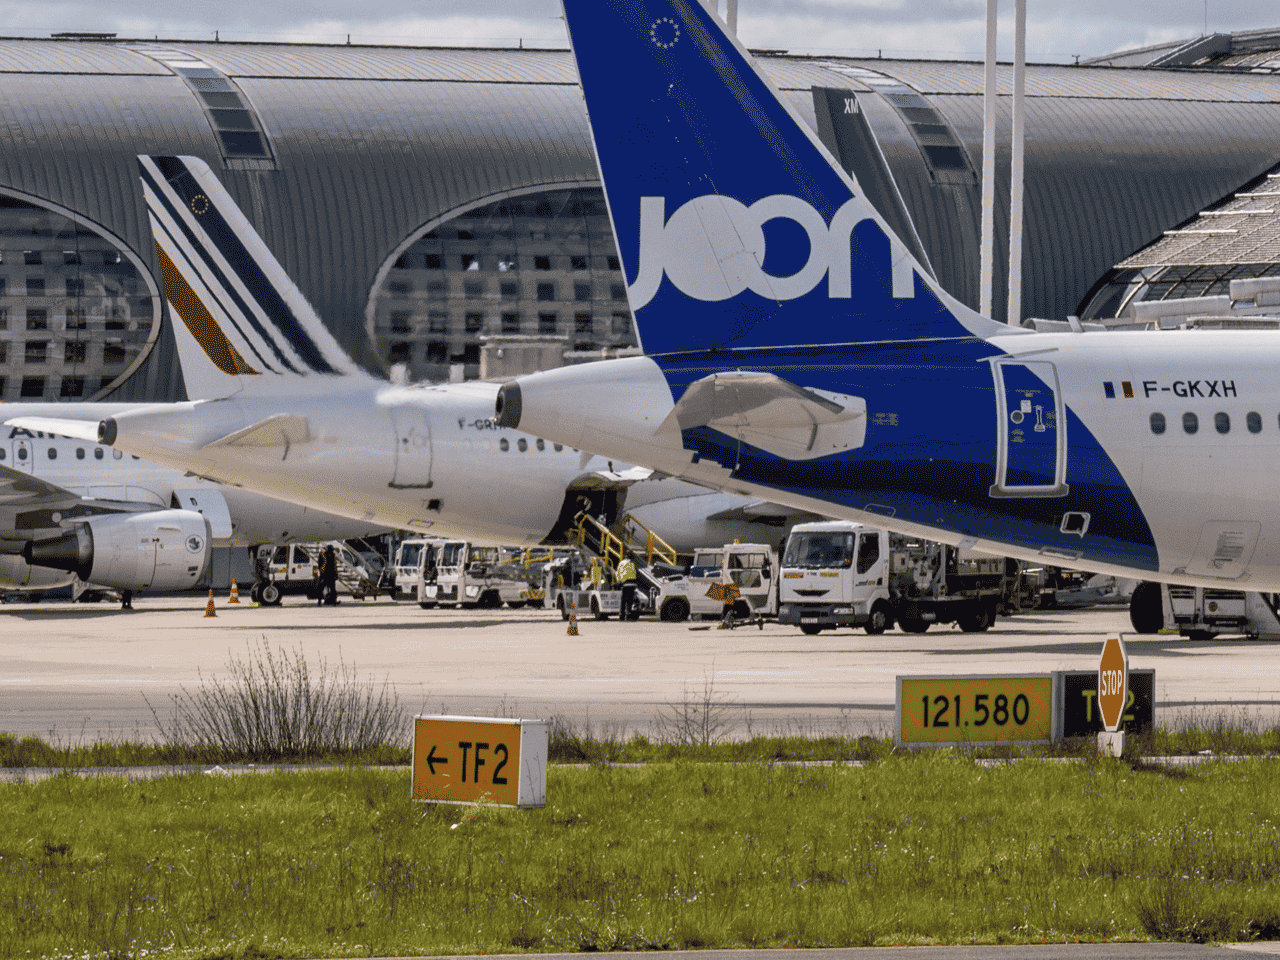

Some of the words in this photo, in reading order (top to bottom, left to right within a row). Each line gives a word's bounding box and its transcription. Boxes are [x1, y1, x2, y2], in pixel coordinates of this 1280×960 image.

[844, 98, 859, 114] XM
[1142, 380, 1238, 398] F-GKXH
[1102, 669, 1122, 696] STOP
[922, 693, 1029, 728] 121.580
[1082, 690, 1135, 722] T2
[459, 741, 508, 785] TF2
